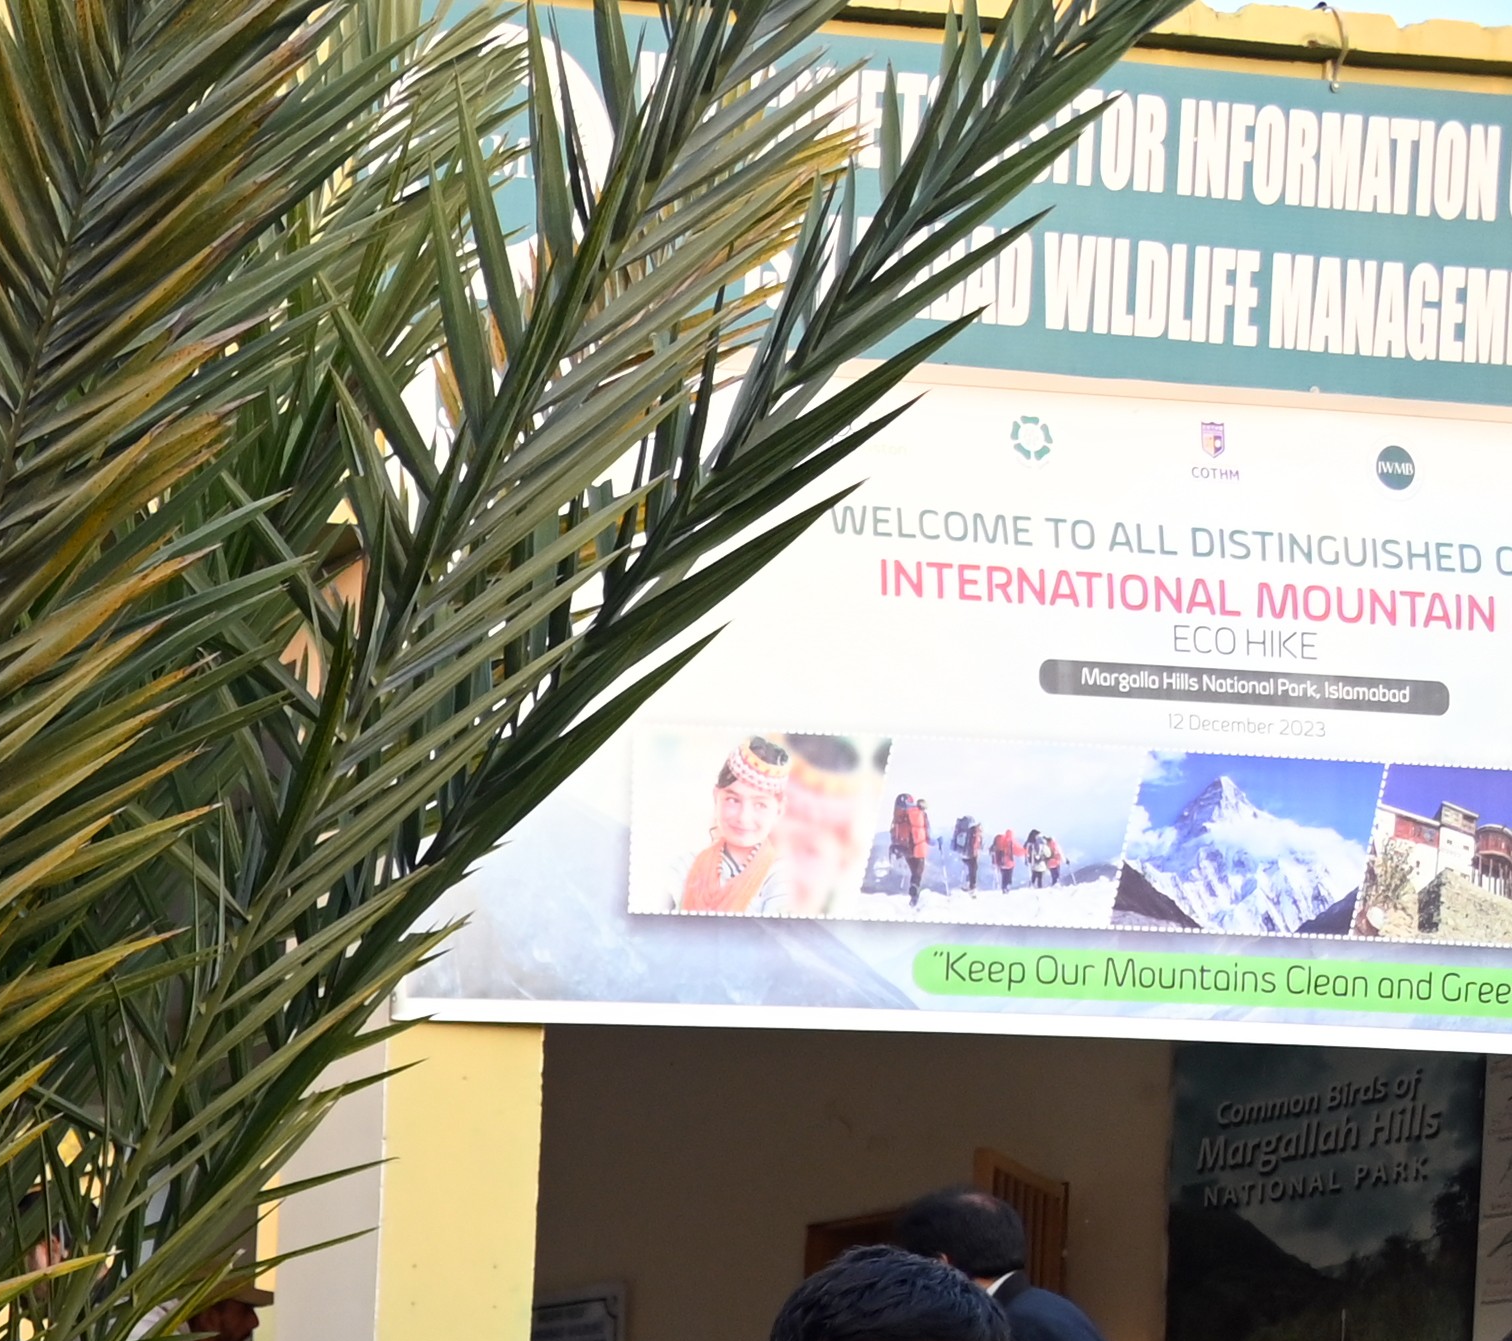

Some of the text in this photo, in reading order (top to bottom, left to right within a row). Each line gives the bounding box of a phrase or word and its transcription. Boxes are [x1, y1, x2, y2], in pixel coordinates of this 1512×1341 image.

[1177, 97, 1502, 222] INFORMATION
[1043, 230, 1261, 348] WILDLIFE
[1191, 465, 1240, 481] COTHM
[830, 504, 1033, 546] WELCOME
[1044, 516, 1096, 551] TO
[1108, 520, 1178, 556] ALL
[1190, 526, 1482, 574] DISTINGUISHED
[880, 557, 1495, 632] INTERNATIONAL MOUNTAIN
[1173, 624, 1318, 661] ECO HIKE
[1080, 666, 1410, 704] Margalla Hills National Park, Islamabad
[1167, 712, 1327, 738] 12 December 2023
[1035, 954, 1096, 987] Our
[1104, 956, 1277, 993] Mountains
[1286, 964, 1369, 998] Clean
[1377, 970, 1433, 1001] and
[1216, 1068, 1424, 1128] Common Birds of
[1196, 1102, 1442, 1175] Margallah Hills
[1202, 1155, 1431, 1210] NATIONAL PARK
